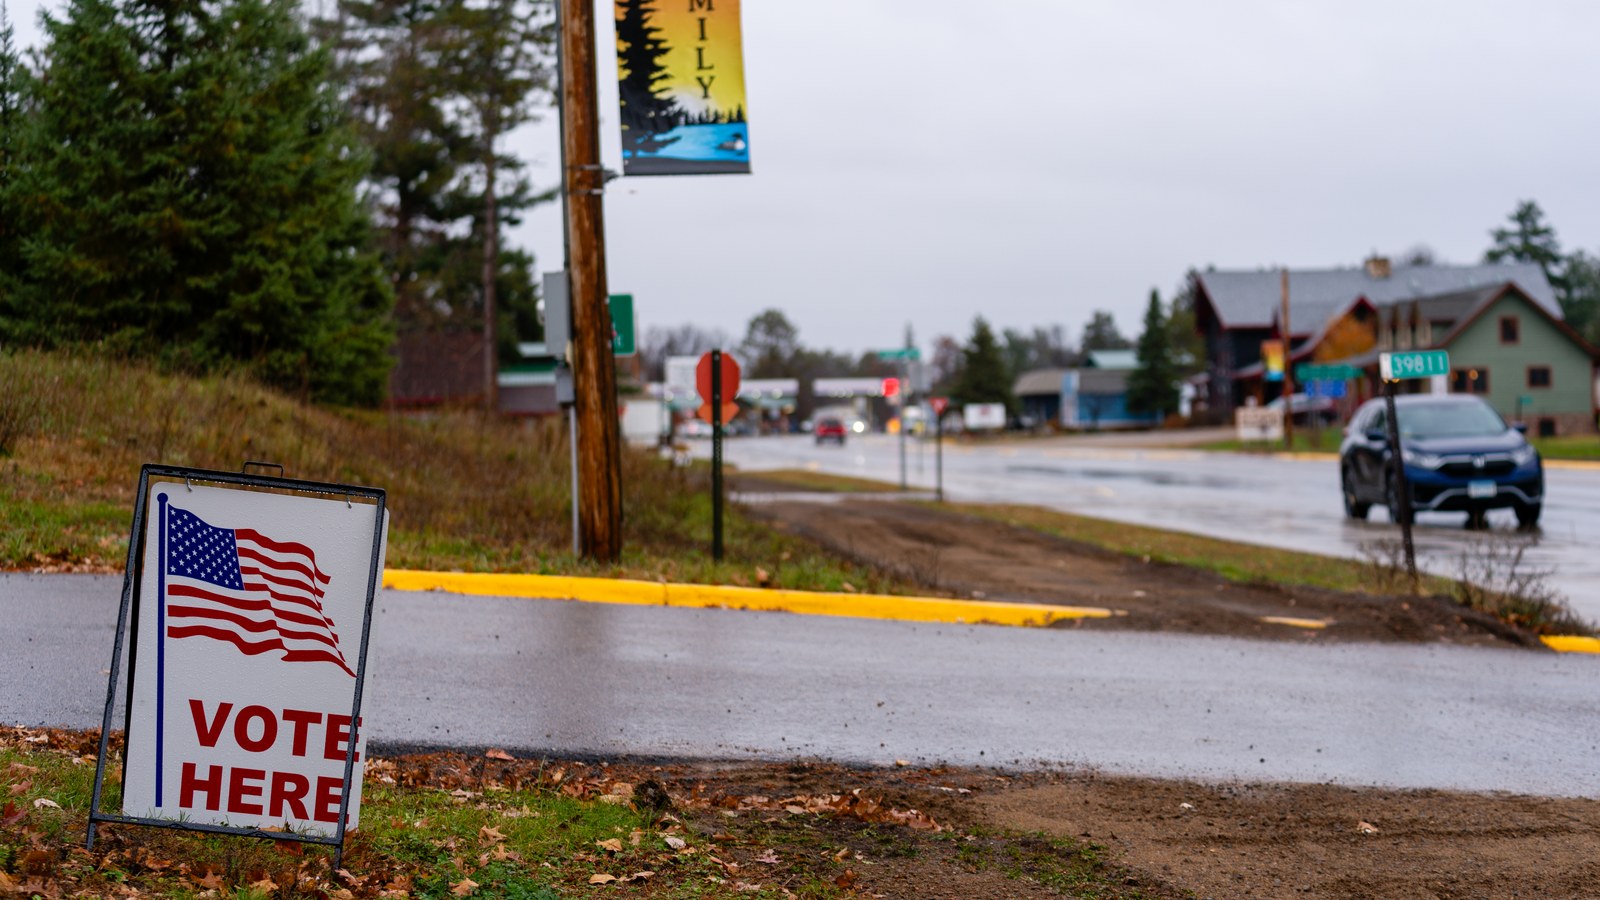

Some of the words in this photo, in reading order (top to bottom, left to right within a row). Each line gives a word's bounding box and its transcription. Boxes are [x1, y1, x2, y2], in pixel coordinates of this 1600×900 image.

[1393, 354, 1444, 375] 39811
[189, 699, 363, 762] VOTE
[179, 762, 353, 824] HERE
